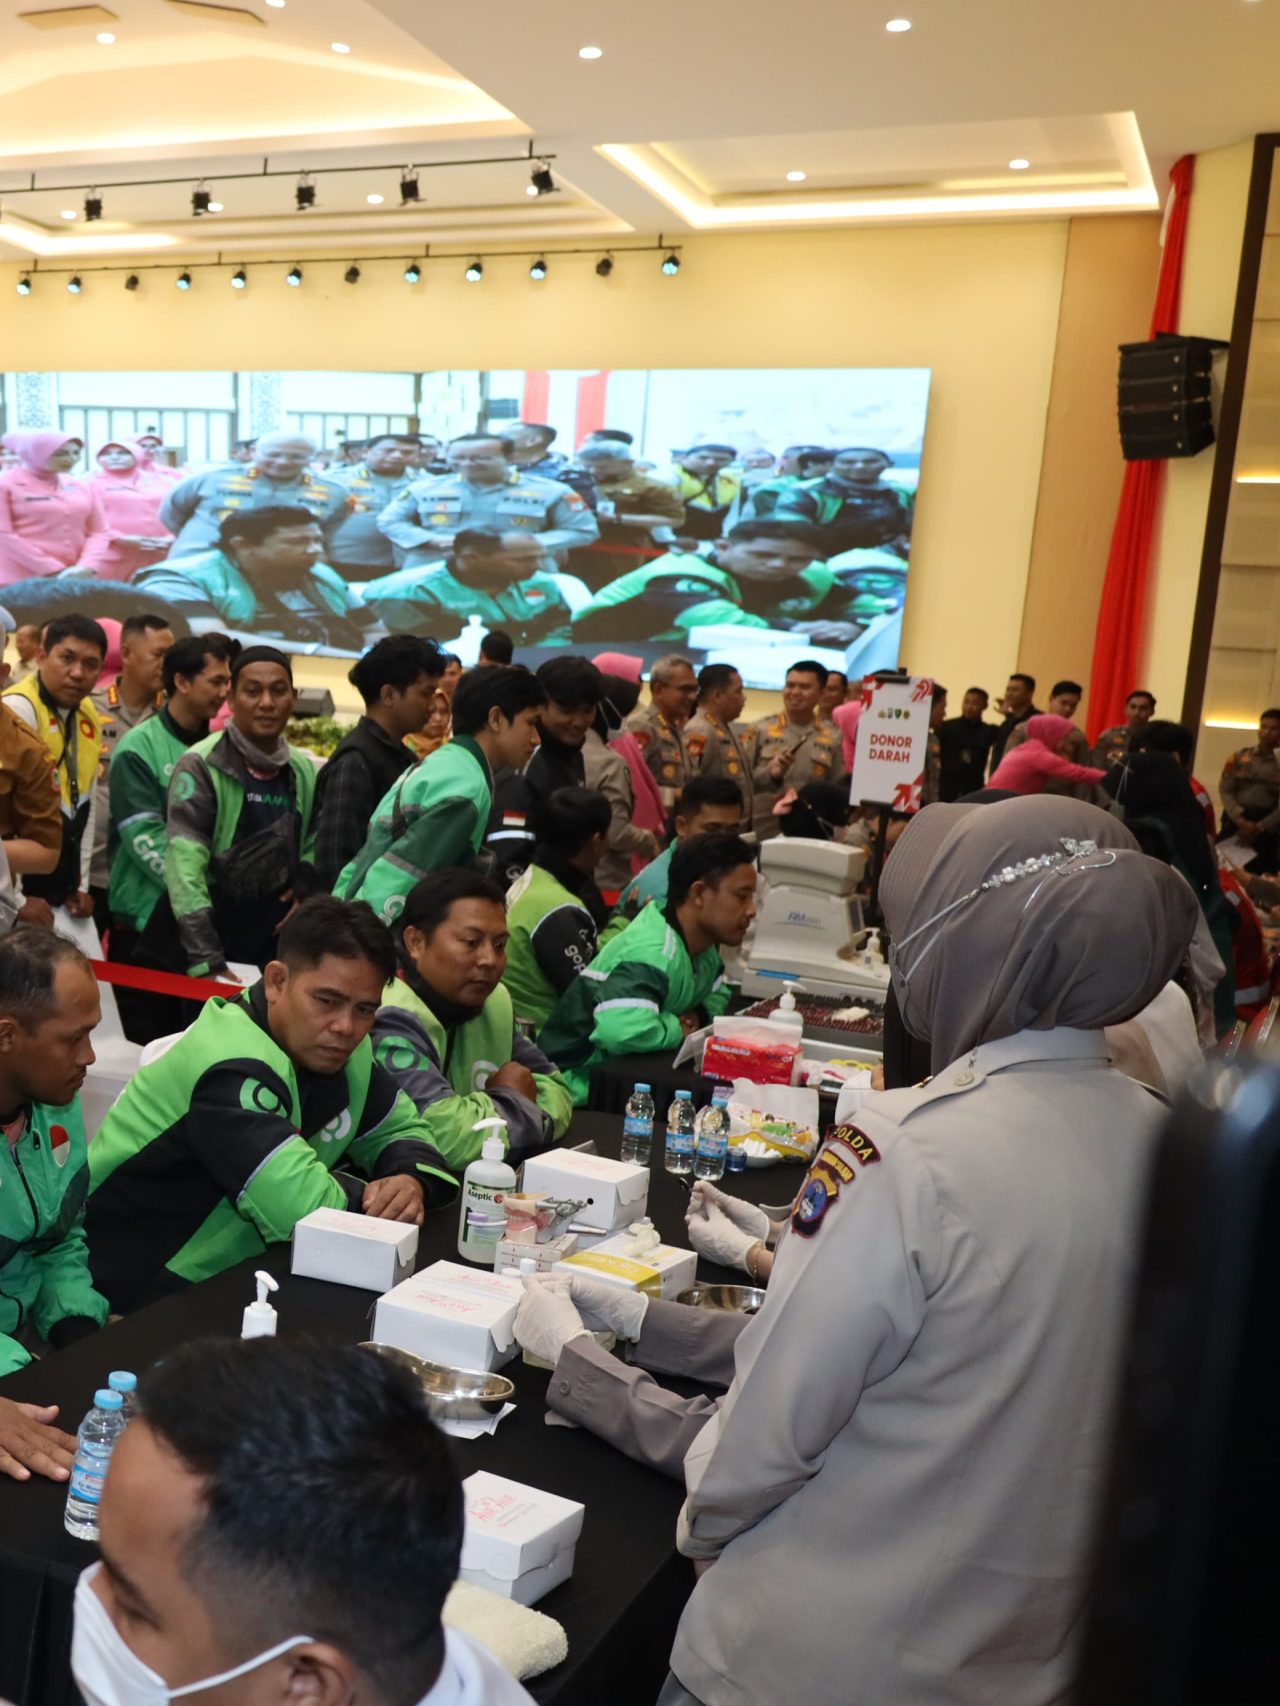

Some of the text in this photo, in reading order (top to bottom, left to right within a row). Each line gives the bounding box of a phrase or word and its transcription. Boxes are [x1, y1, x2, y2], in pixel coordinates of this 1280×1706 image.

[870, 734, 913, 748] DONOR
[869, 748, 910, 763] DARAH
[133, 833, 167, 876] Gra
[467, 1188, 493, 1202] Aseptic
